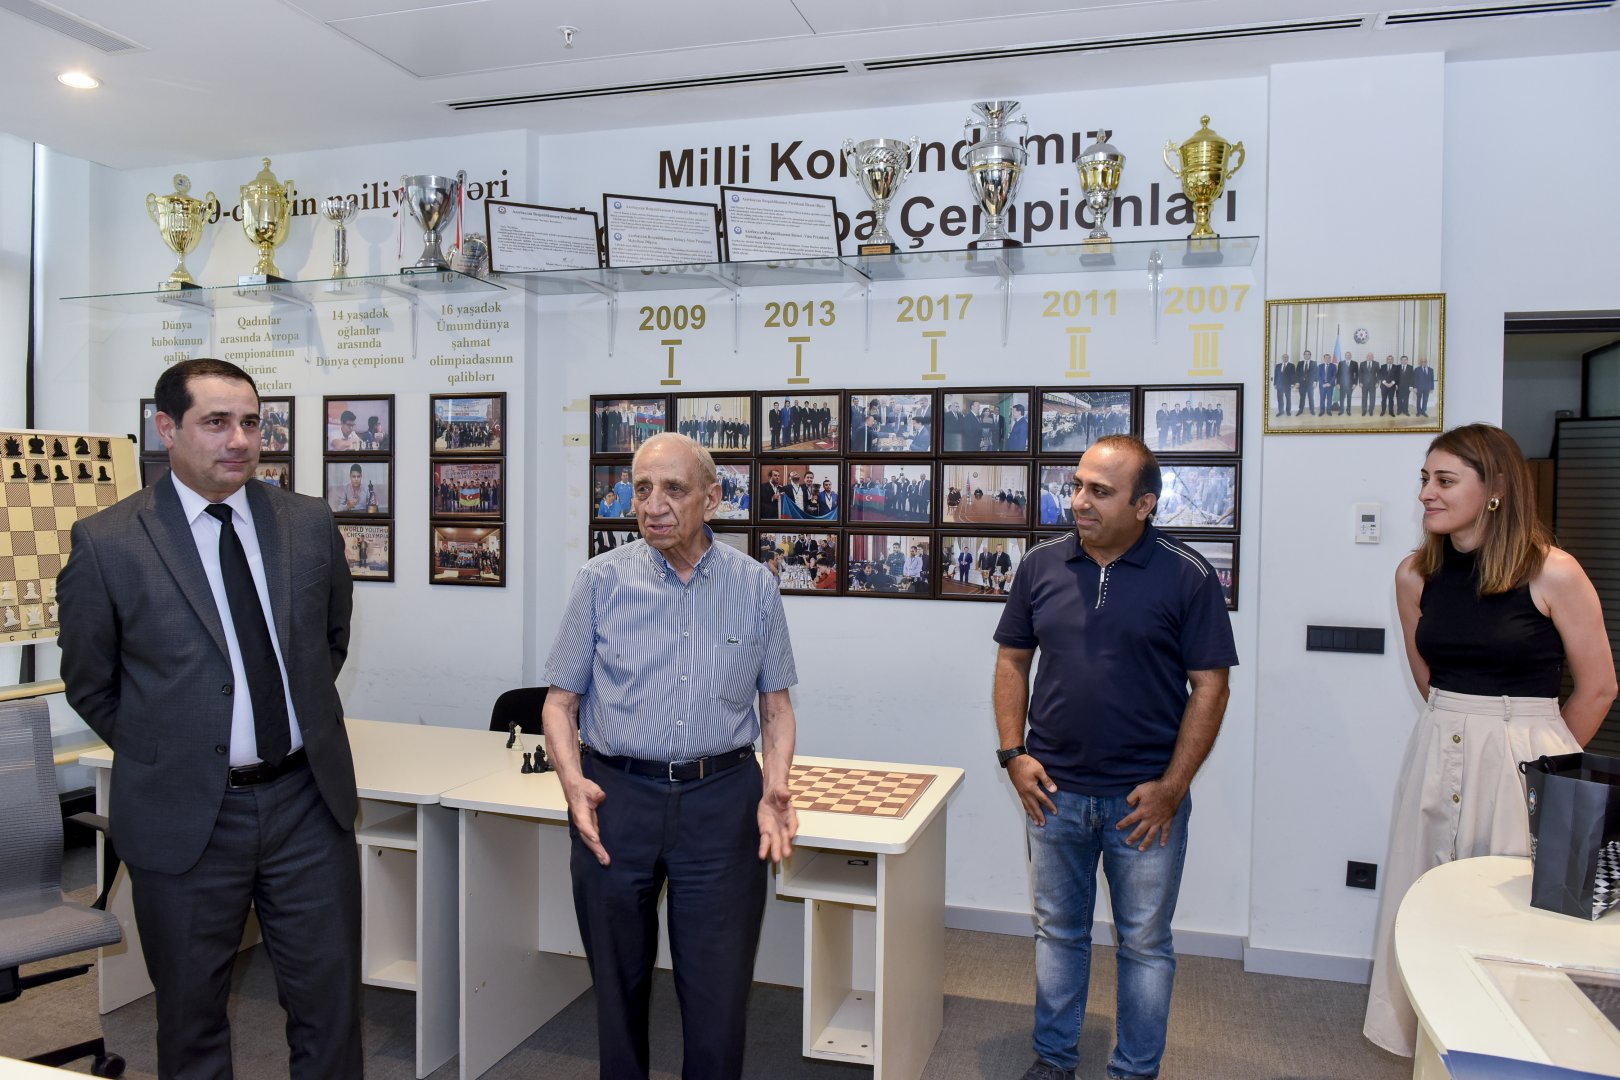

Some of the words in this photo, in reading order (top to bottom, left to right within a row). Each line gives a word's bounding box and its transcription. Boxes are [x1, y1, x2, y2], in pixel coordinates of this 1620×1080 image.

[659, 144, 750, 189] Milli
[1042, 288, 1118, 318] 2011
[1163, 284, 1251, 315] 2007
[332, 310, 344, 320] 14
[347, 307, 389, 323] yaşadək
[441, 304, 454, 315] 16
[456, 301, 502, 318] yaşadək
[764, 300, 836, 328] 2013
[896, 293, 974, 323] 2017
[436, 318, 510, 333] Ümumdünya
[639, 304, 706, 331] 2009
[162, 320, 193, 333] Dünya
[337, 325, 381, 339] oğlanlar
[151, 337, 203, 347] kubokunun
[220, 332, 261, 344] arasında
[263, 331, 300, 344] Avropa
[337, 338, 382, 349] arasında
[451, 337, 491, 351] şahmat
[224, 348, 295, 361] çempionatının
[1065, 327, 1092, 378] II
[1187, 323, 1225, 377] III
[316, 356, 349, 369] Dünya
[352, 354, 404, 368] çempionu
[429, 353, 513, 369] olimpiadasının
[31, 631, 37, 639] d
